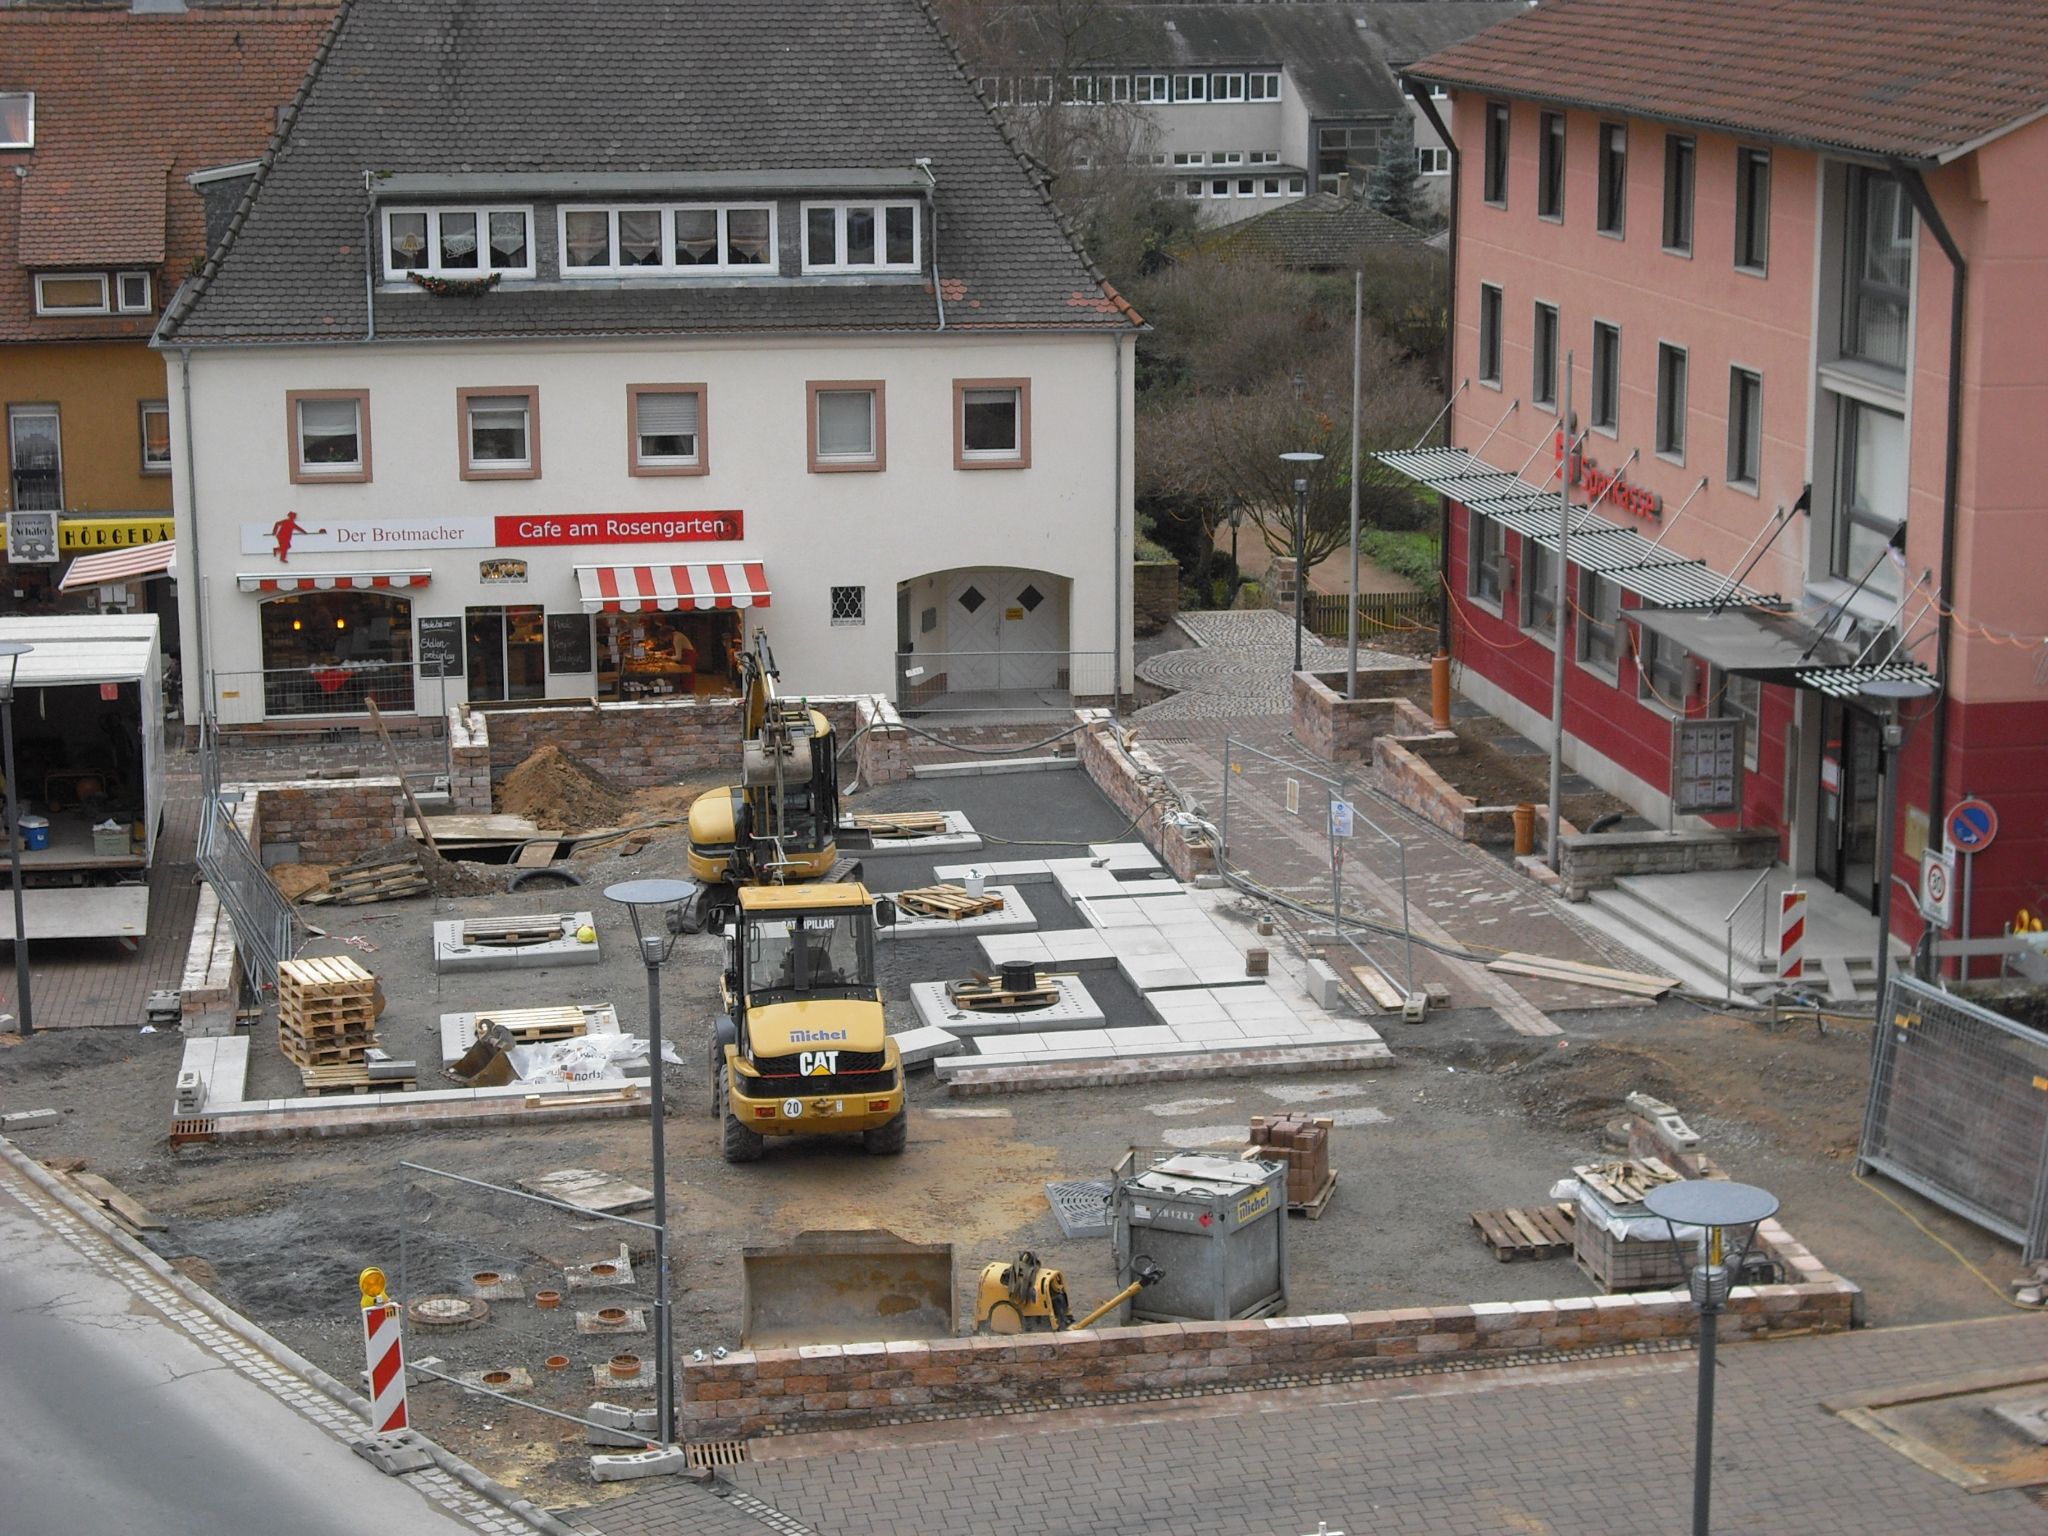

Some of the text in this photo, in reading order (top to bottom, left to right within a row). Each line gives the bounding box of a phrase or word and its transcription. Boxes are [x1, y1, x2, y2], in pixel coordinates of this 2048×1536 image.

[1579, 454, 1655, 522] Sparkasse
[65, 524, 175, 545] HÖRGERÄ
[337, 526, 465, 543] Der Brotmacher
[519, 518, 724, 537] Cafe am Rosengarten
[790, 1029, 847, 1042] Michel
[799, 1051, 839, 1077] CAT
[786, 1102, 799, 1115] 20
